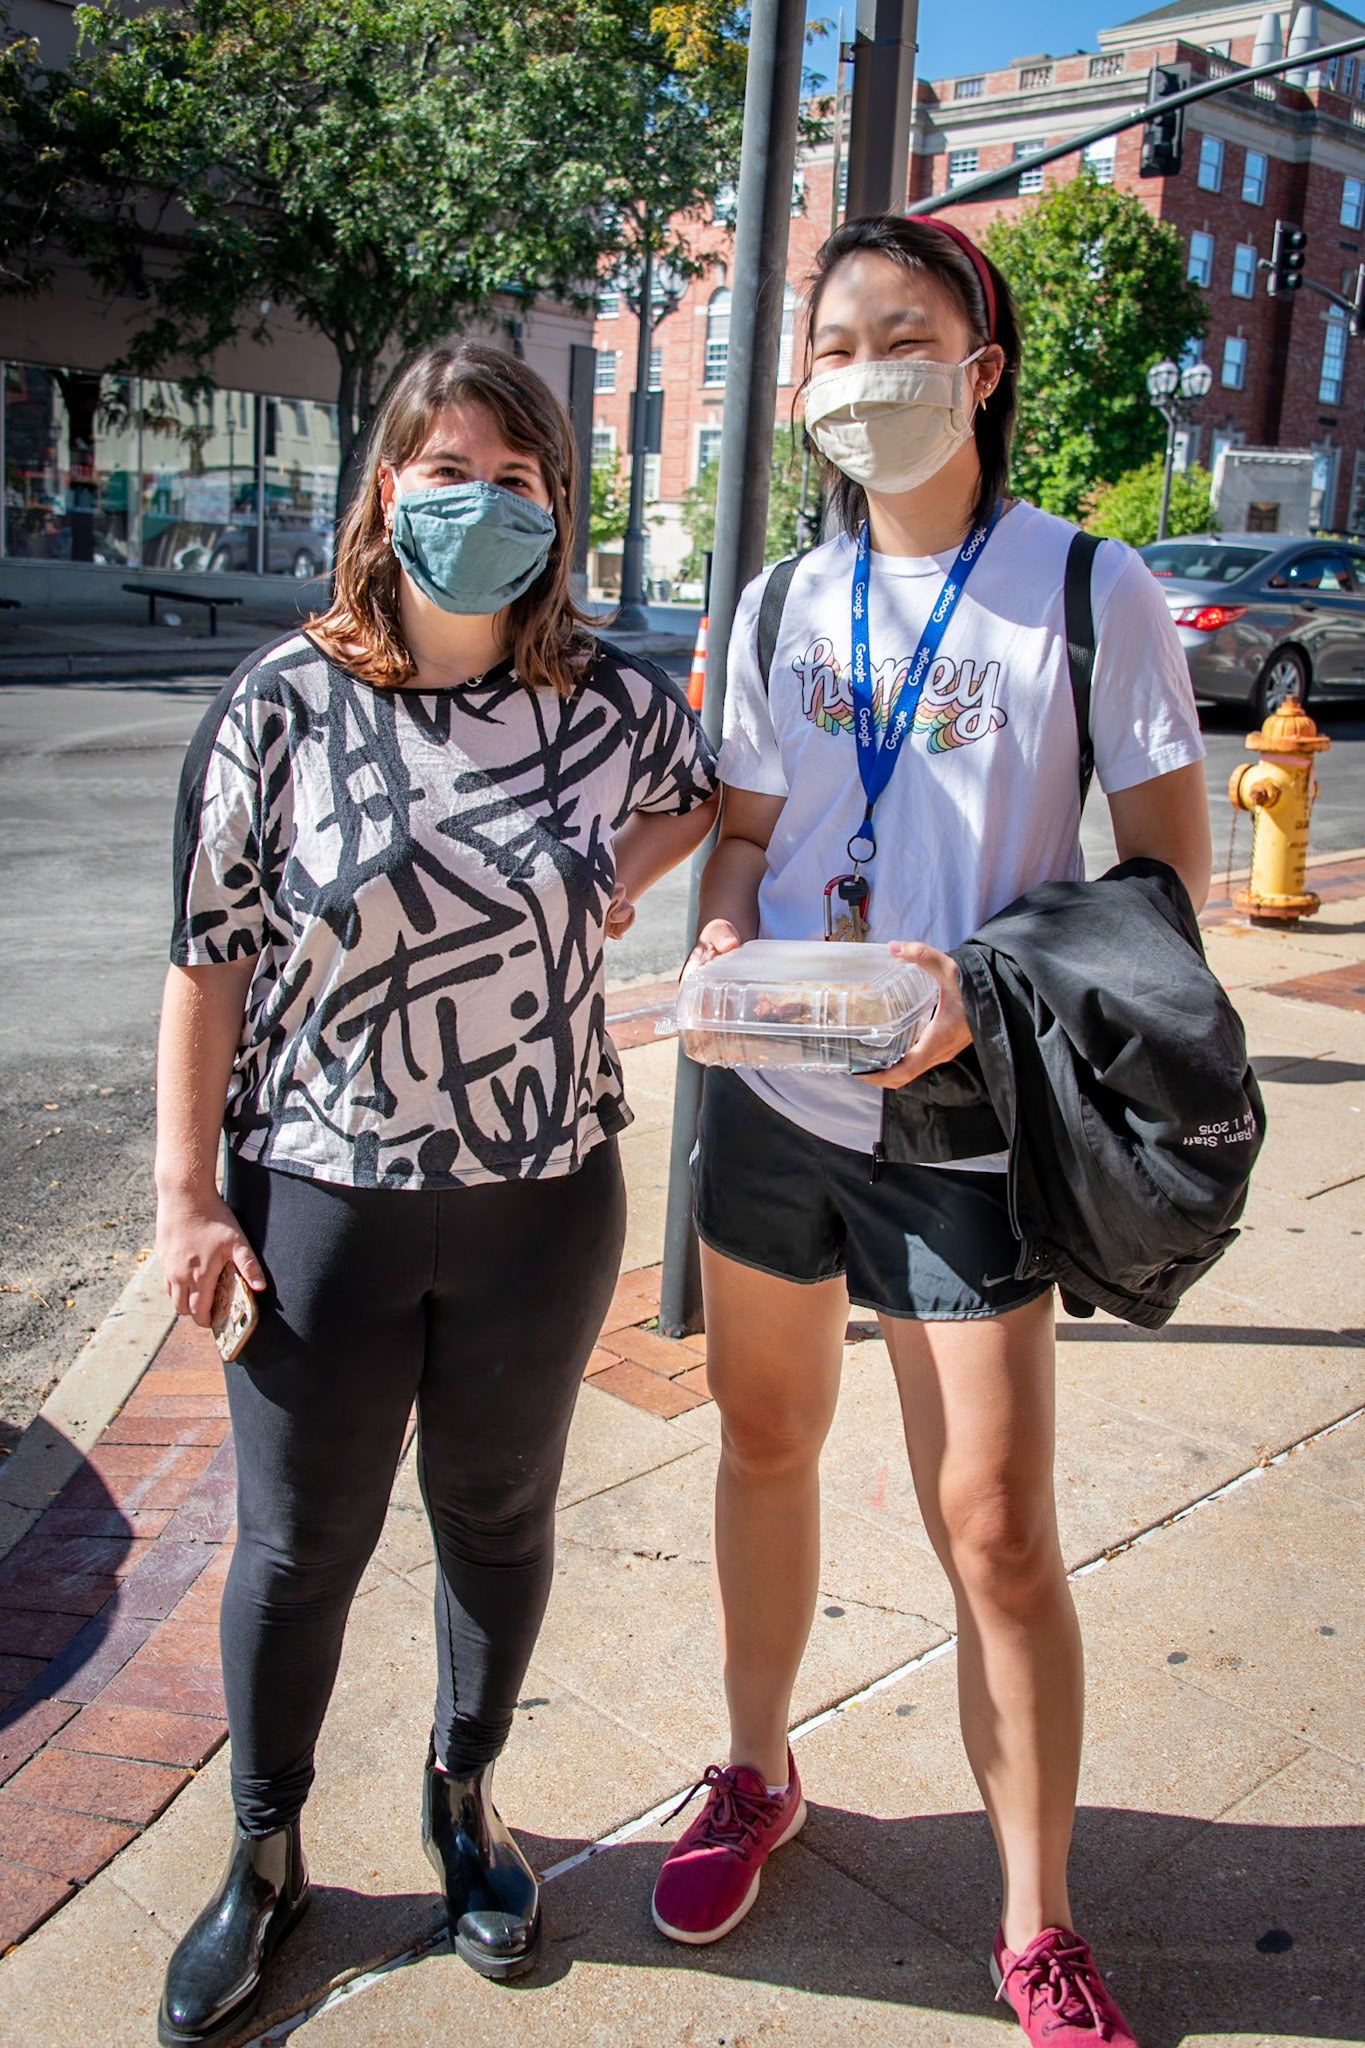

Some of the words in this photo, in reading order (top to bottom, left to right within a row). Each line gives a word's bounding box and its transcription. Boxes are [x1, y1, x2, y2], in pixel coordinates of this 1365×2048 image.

[852, 581, 866, 620] Google
[853, 643, 868, 684] Google
[886, 710, 908, 750] Google
[908, 646, 931, 687] Google
[932, 583, 957, 623] Google
[791, 637, 1008, 742] honey
[858, 707, 873, 748] Google
[1182, 1136, 1218, 1147] Staff
[1198, 1121, 1229, 1136] 2015
